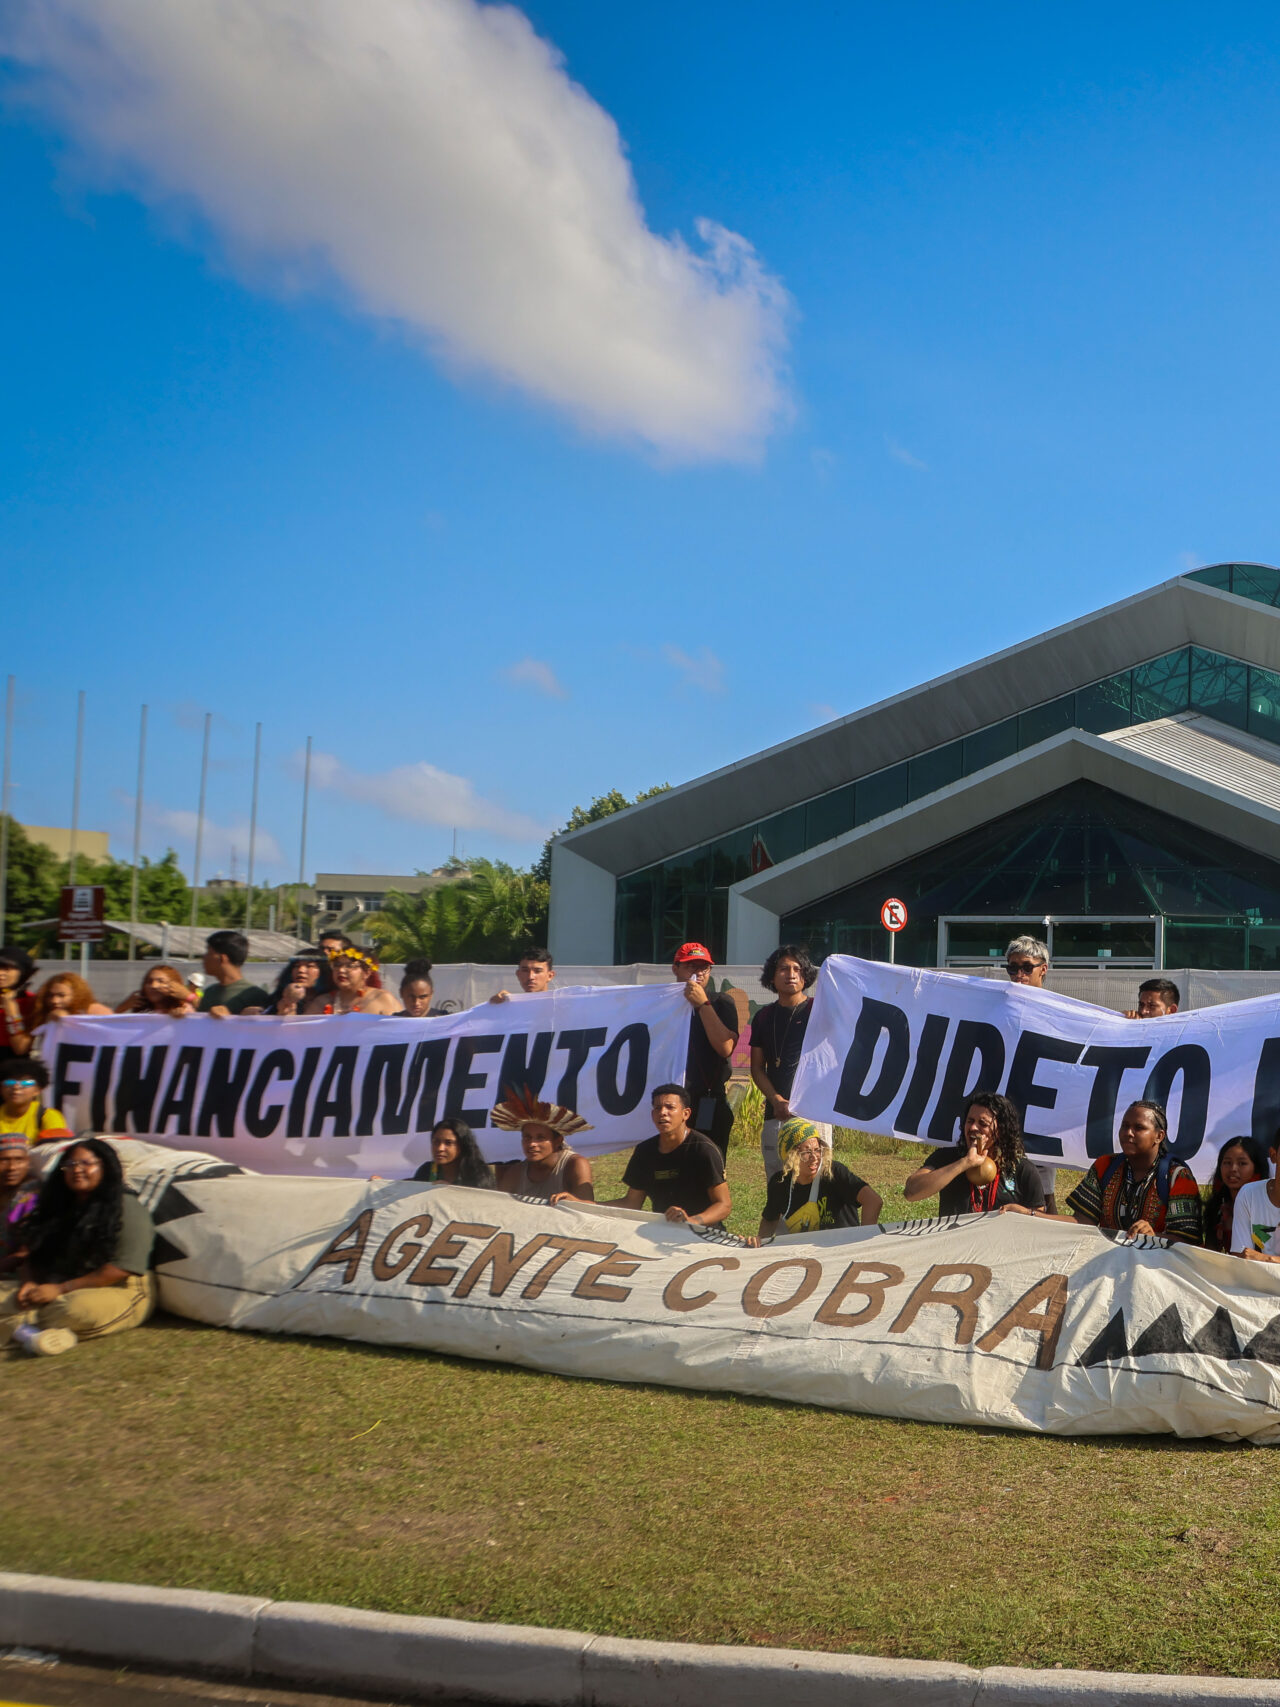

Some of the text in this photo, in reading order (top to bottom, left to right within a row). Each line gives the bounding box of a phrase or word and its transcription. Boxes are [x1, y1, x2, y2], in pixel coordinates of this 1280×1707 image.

[53, 1022, 651, 1138] FINANCIAMENTO
[832, 996, 1211, 1162] DIRETO
[295, 1208, 1070, 1371] AGENTE COBRA
